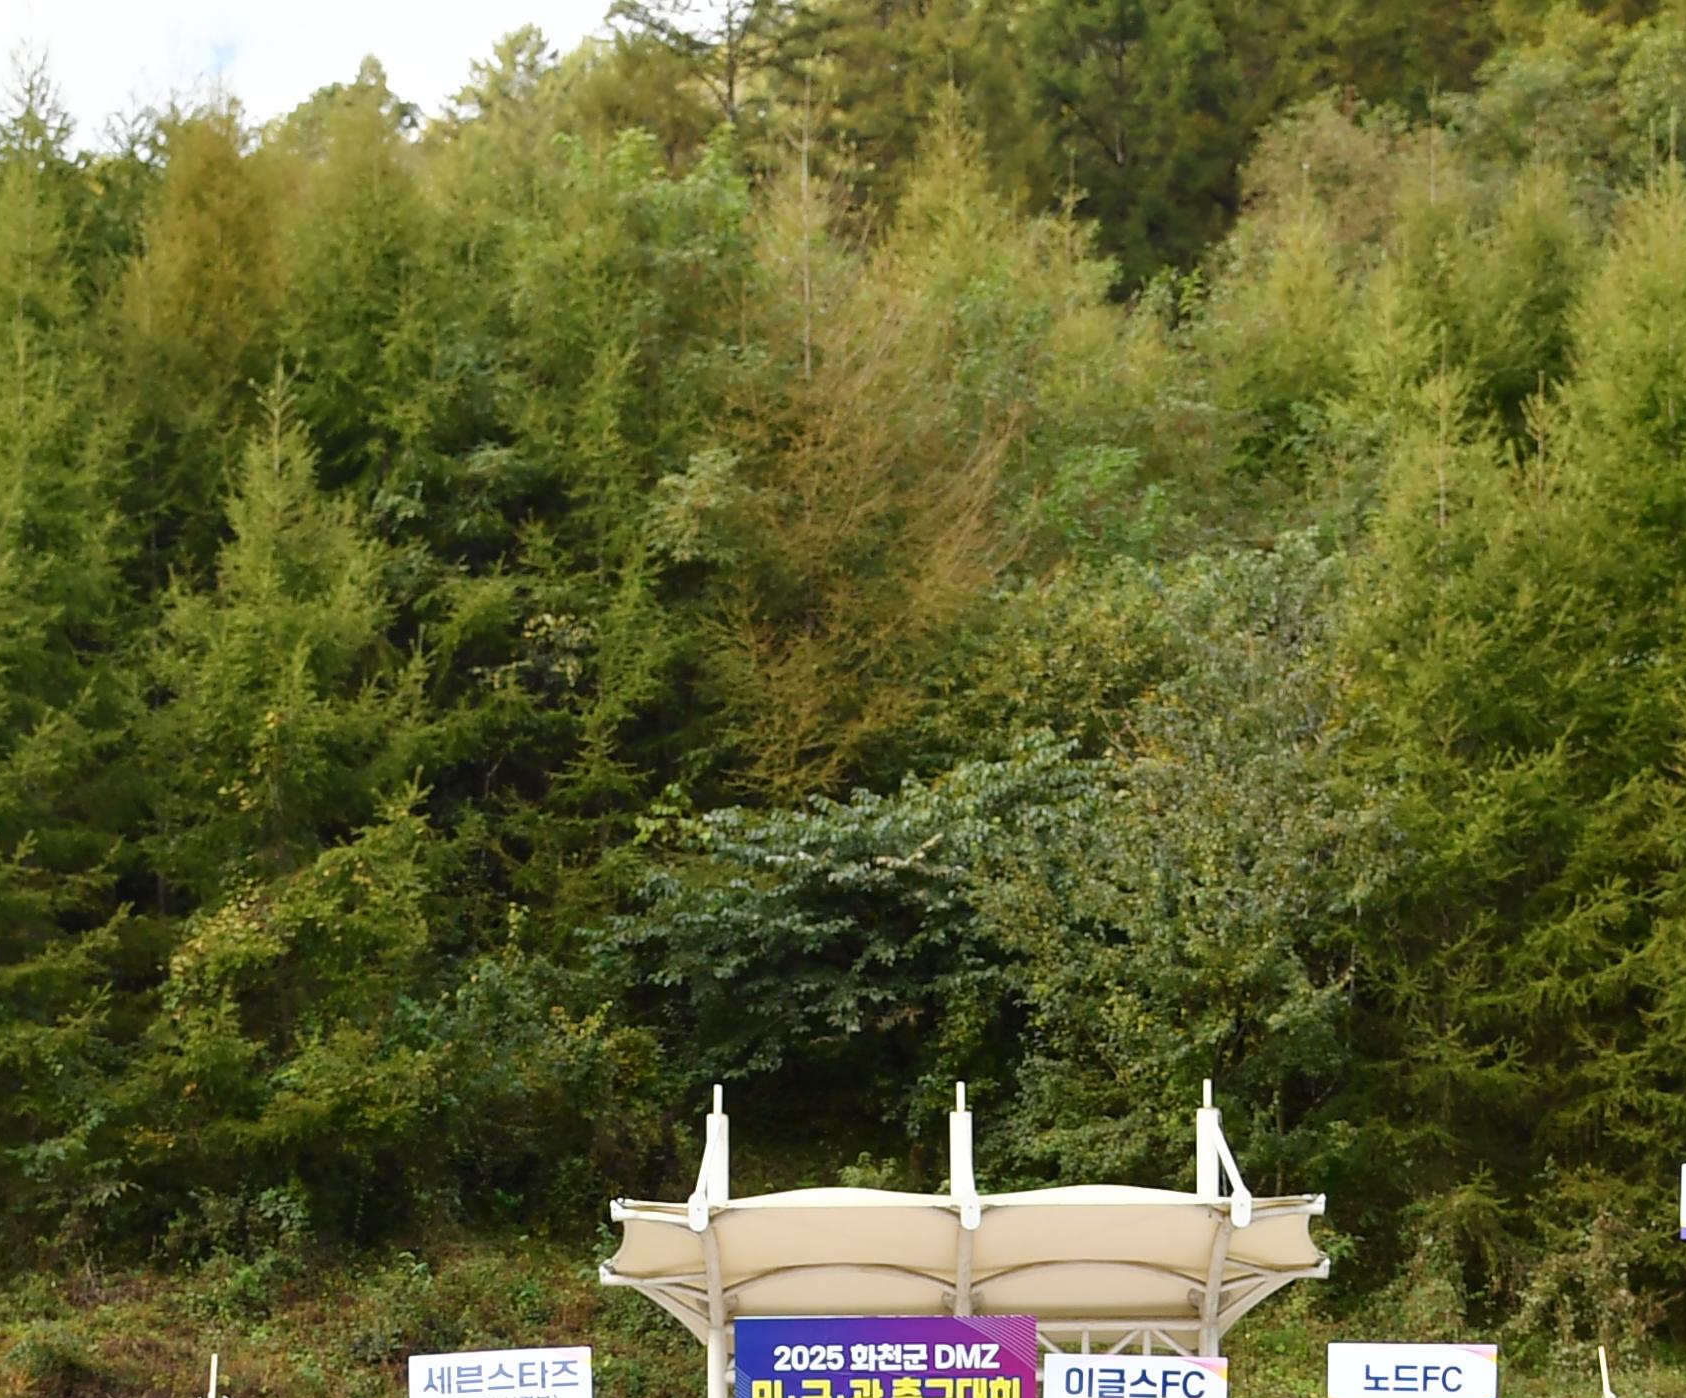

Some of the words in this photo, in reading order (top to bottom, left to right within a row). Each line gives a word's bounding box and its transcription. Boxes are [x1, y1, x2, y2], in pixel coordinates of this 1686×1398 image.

[773, 1344, 845, 1372] 2025
[849, 1342, 928, 1372] 화천군
[934, 1343, 1001, 1370] DMZ
[423, 1360, 579, 1395] 세븐스타즈
[1364, 1364, 1463, 1392] 노드FC
